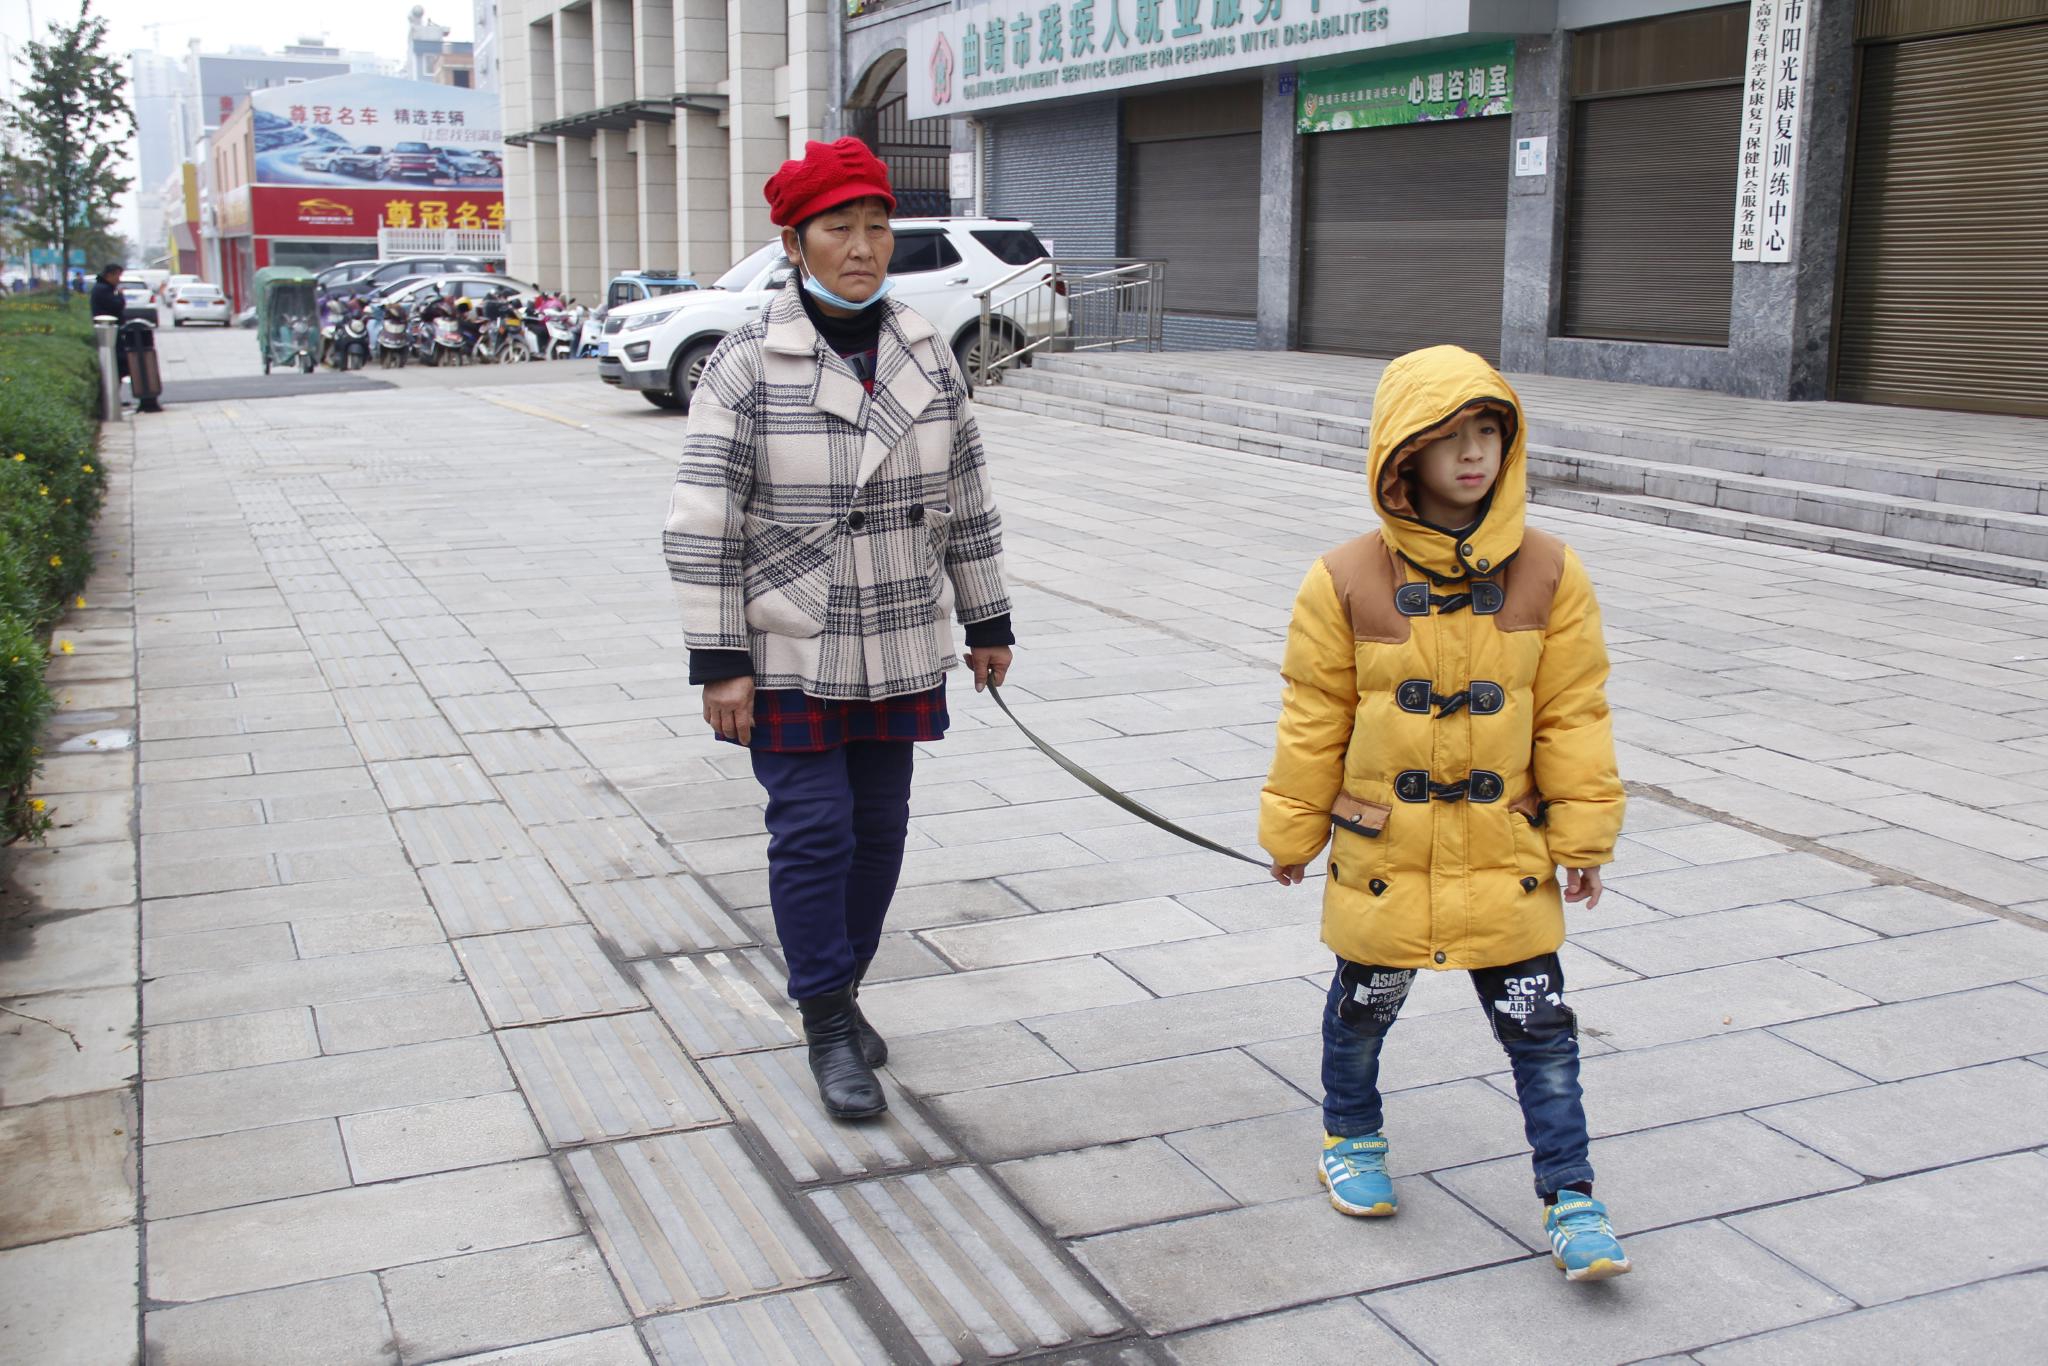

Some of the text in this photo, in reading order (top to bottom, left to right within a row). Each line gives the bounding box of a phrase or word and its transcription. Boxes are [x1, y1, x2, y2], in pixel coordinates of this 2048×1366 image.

[962, 0, 1373, 79] 曲靖市残疾人就业
[996, 69, 1059, 95] EMPLOYMENT
[1061, 60, 1106, 82] SERVICE
[1107, 52, 1148, 77] CENTRE
[1150, 48, 1173, 69] FOR
[1175, 36, 1236, 65] PERSONS
[1240, 28, 1278, 53] WITH
[1282, 7, 1389, 47] DISABILITIES
[289, 104, 465, 126] 尊冠名车 精选车辆
[1408, 64, 1508, 105] 心理咨询室
[1738, 0, 1772, 251] 高等专科学校康复与保健社会服务基地
[1765, 0, 1802, 252] 市阳光康复训练中心
[385, 200, 505, 230] 尊冠名车
